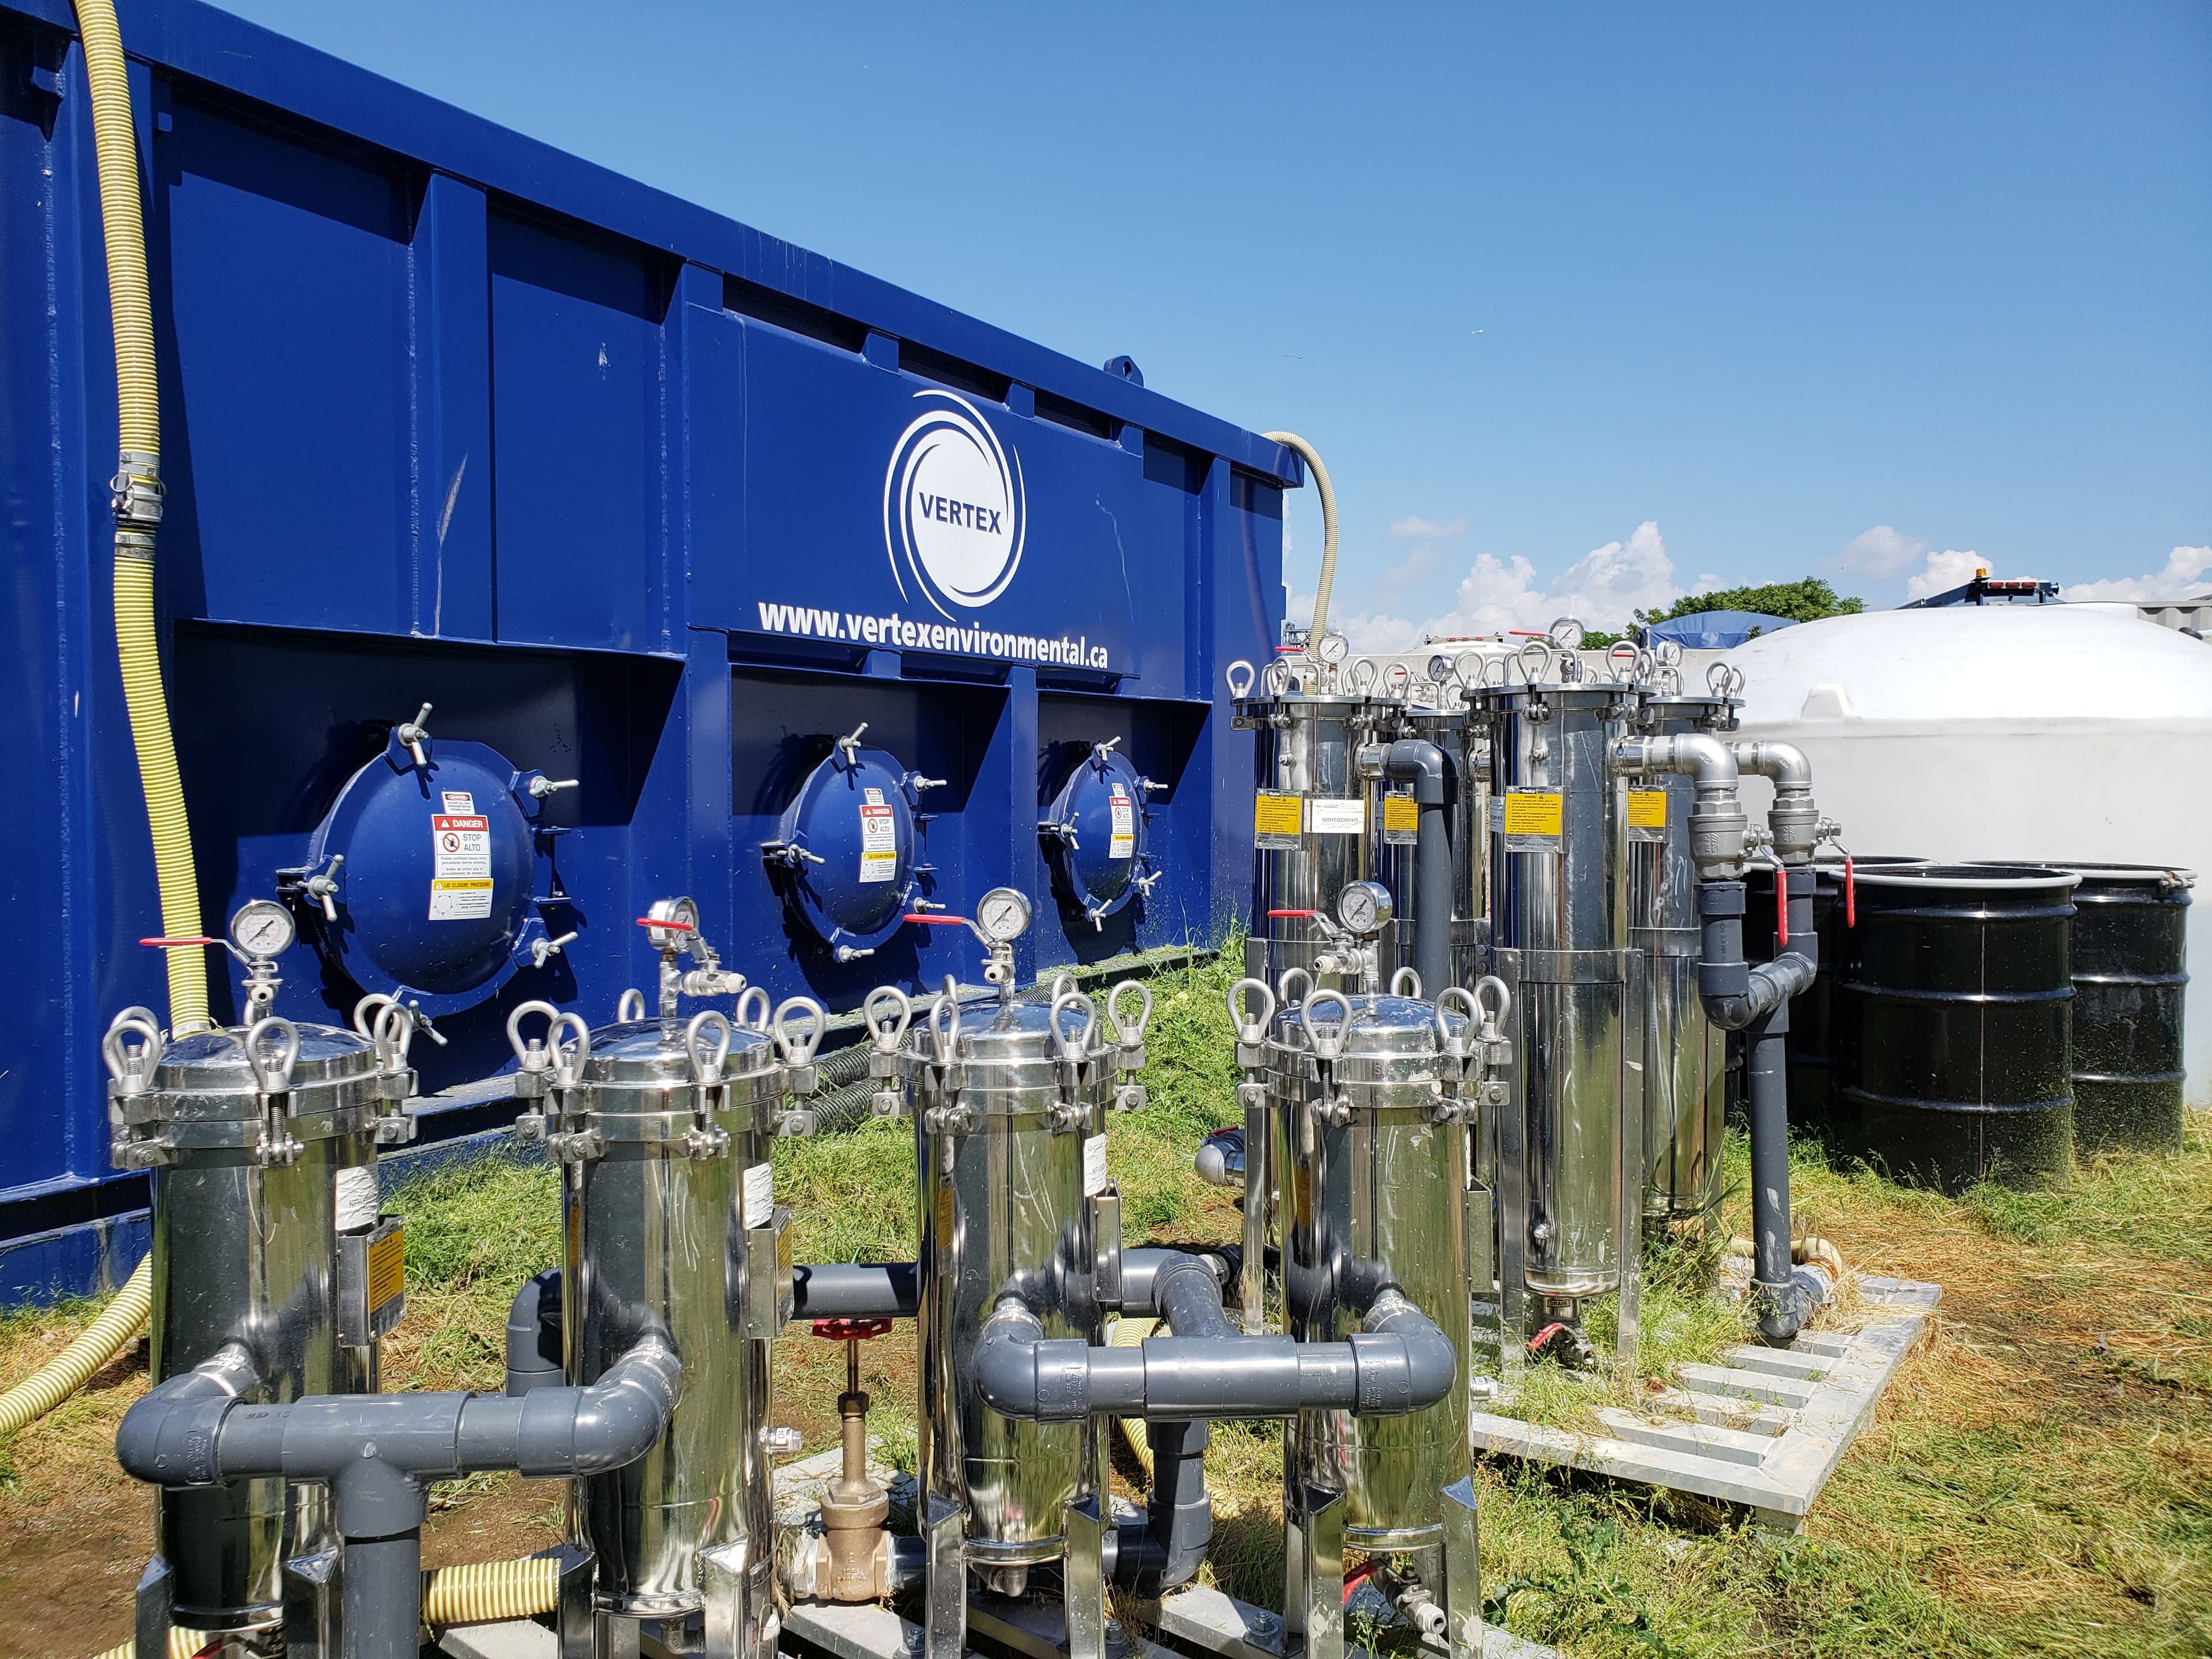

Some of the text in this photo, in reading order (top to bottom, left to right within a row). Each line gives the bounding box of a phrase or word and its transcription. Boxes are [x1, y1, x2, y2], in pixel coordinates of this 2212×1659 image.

[919, 492, 1002, 535] VERTEX
[758, 602, 1108, 668] www.vertexenvironmental.ca
[452, 820, 483, 828] DANGER
[848, 1552, 855, 1563] 2
